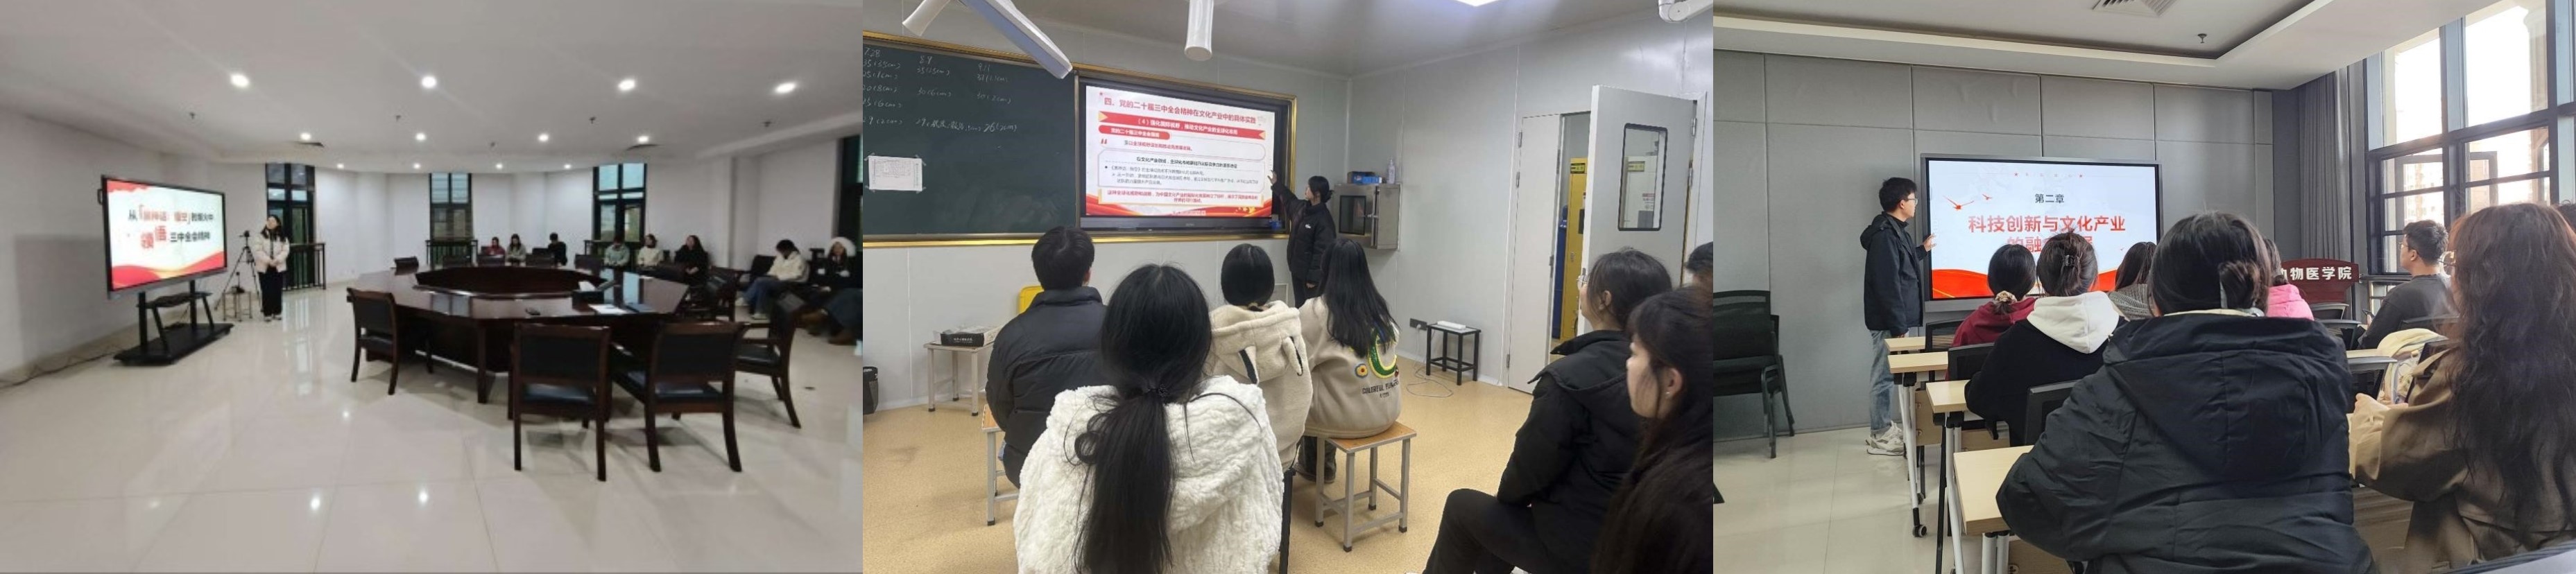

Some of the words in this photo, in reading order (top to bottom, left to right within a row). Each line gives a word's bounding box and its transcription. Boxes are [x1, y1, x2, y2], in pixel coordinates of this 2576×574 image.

[2034, 193, 2065, 203] 第二章
[1968, 215, 2126, 233] 科技创新与文化产业
